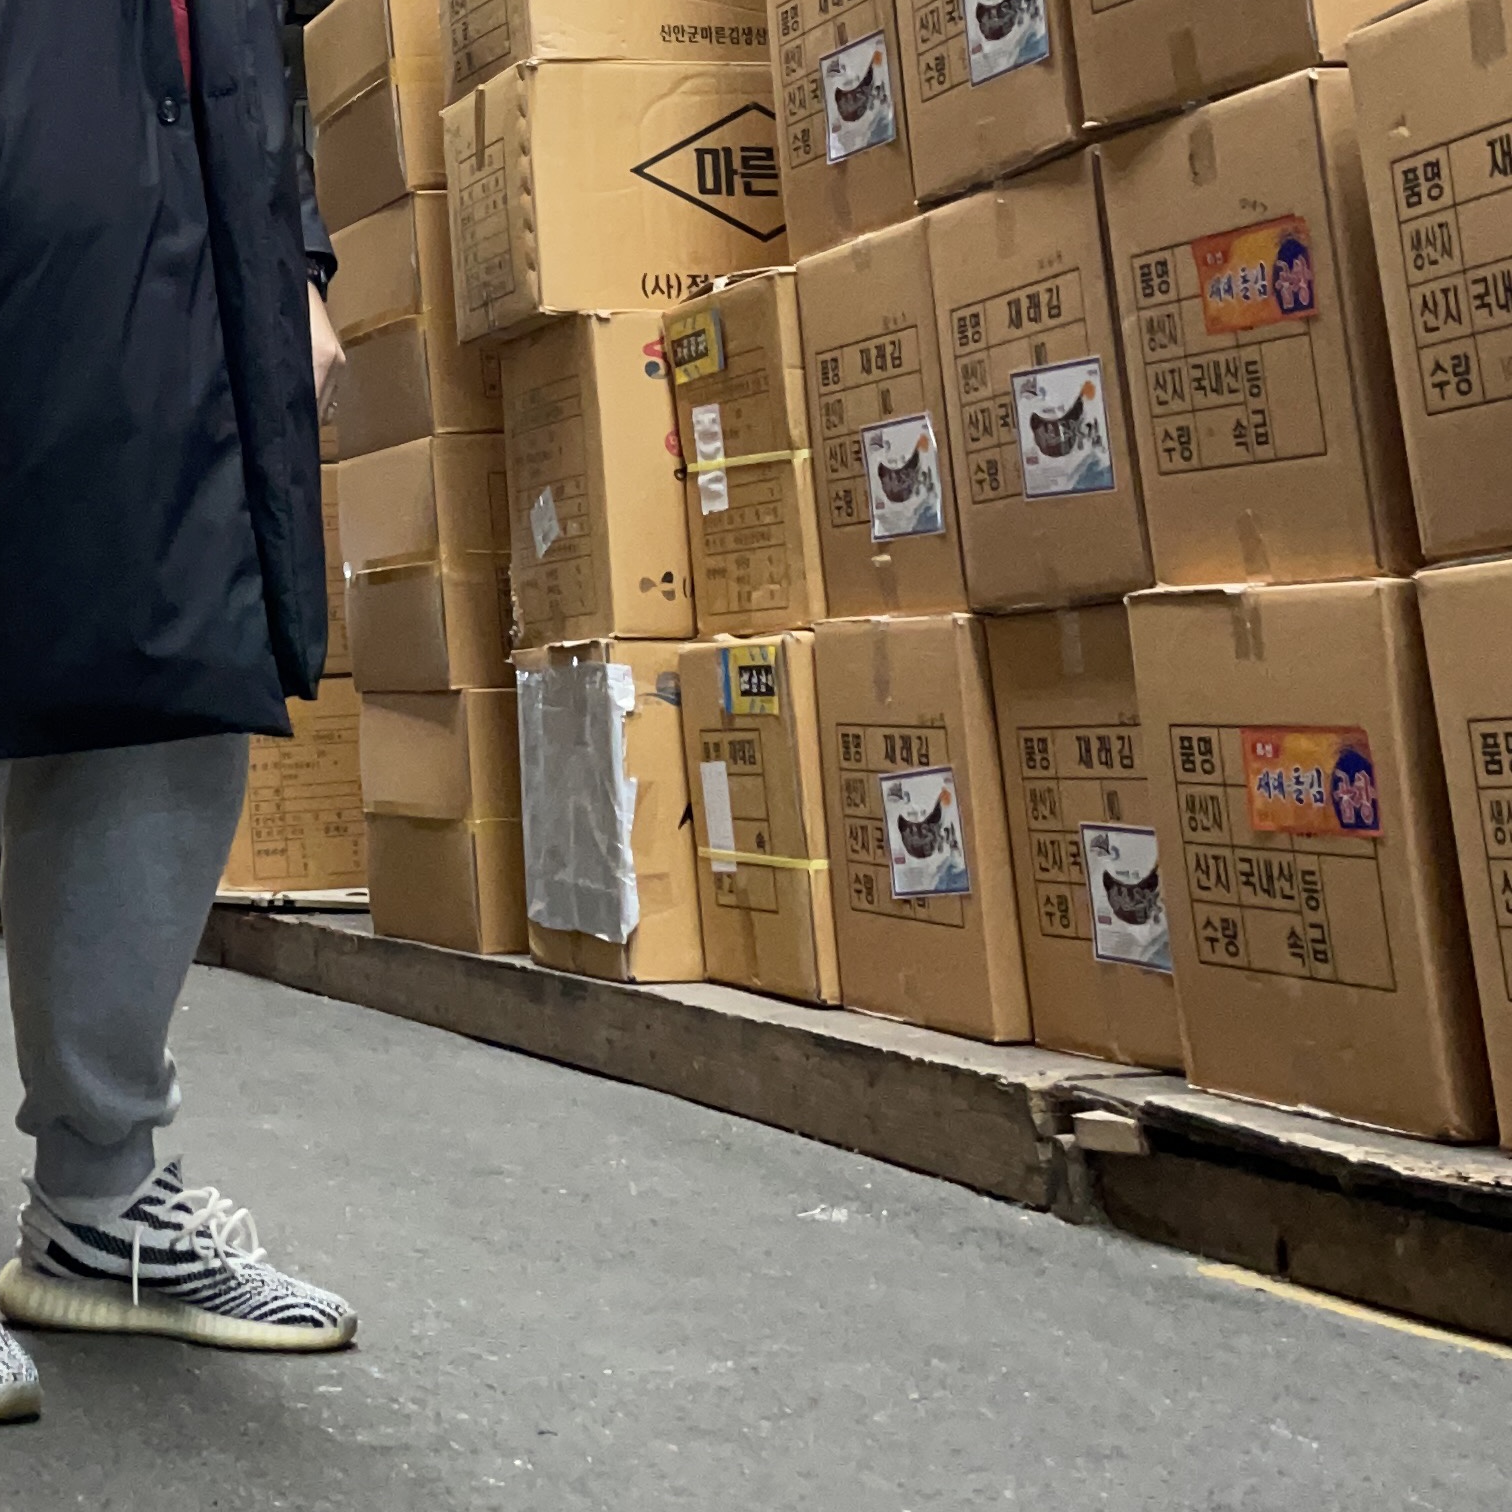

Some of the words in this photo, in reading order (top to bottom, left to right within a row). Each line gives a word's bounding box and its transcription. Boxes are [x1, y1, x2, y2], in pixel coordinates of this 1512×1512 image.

[1402, 158, 1444, 209] 품명
[1139, 256, 1171, 298] 품명
[1421, 284, 1463, 333] 산지
[1152, 370, 1185, 404] 산지
[1430, 352, 1473, 400] 수량
[1161, 424, 1194, 464] 수량
[1179, 736, 1215, 775] 품명
[1194, 854, 1231, 895] 산지
[1201, 920, 1240, 958] 수량
